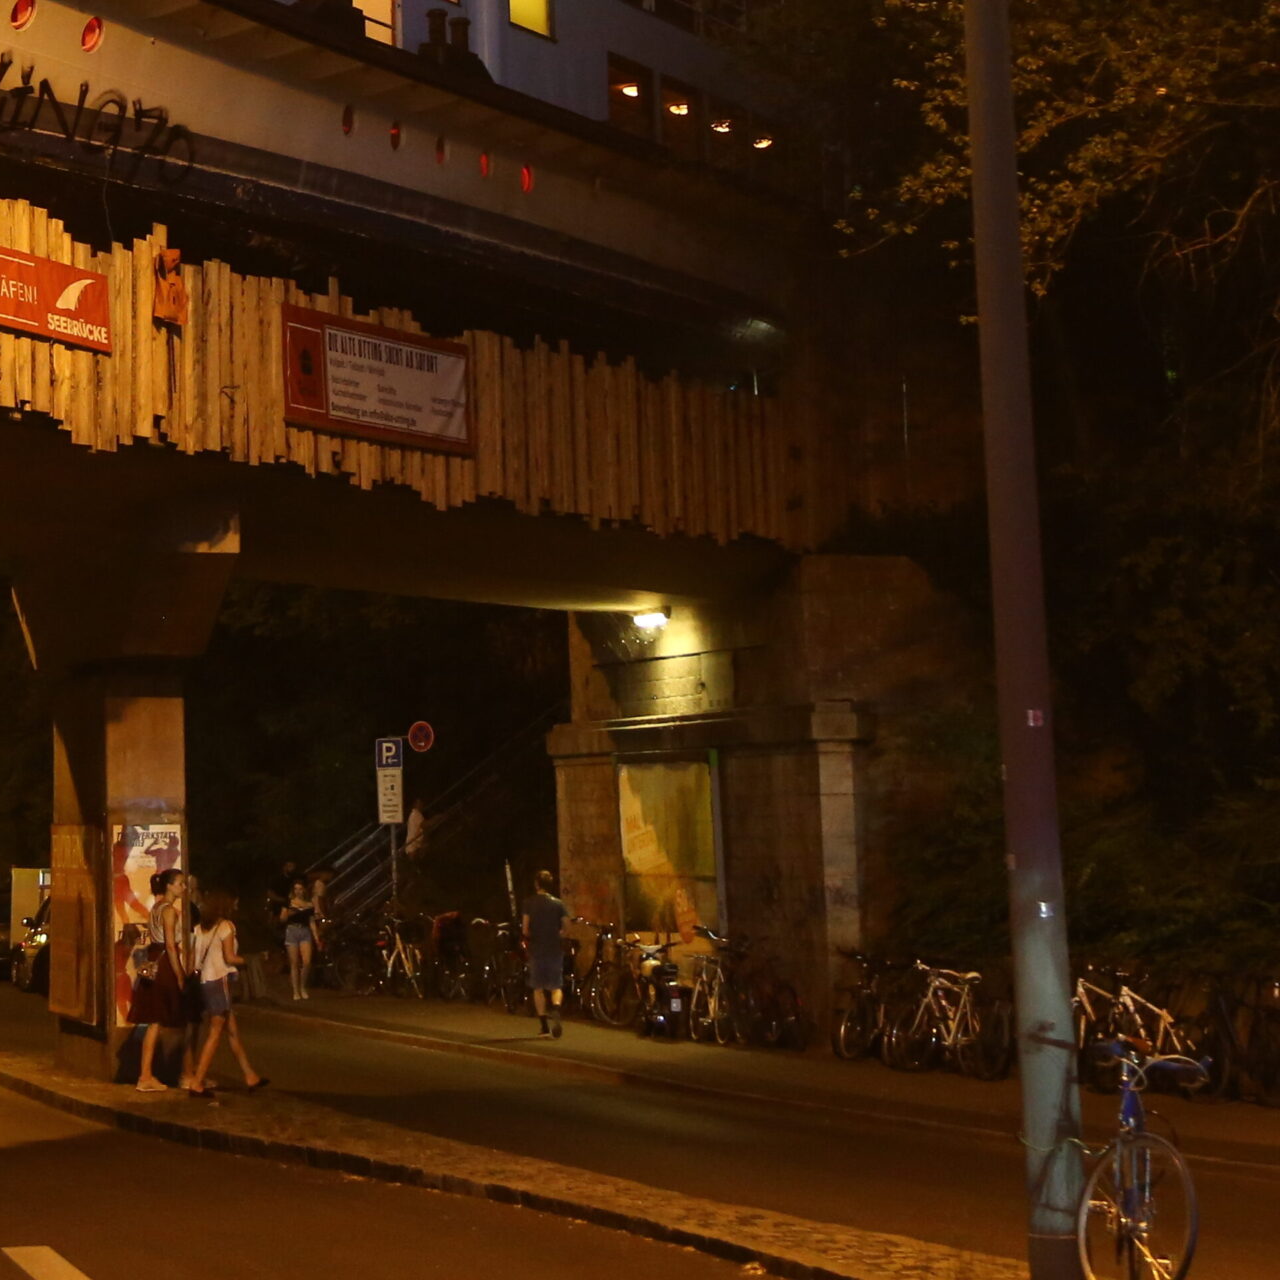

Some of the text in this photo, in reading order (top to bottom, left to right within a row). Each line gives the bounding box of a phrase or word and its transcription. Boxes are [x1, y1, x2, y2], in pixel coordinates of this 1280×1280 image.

[47, 312, 109, 344] SEEBRÜCKE
[328, 331, 339, 353] DIE
[340, 335, 357, 357] ALTE
[358, 338, 383, 362] UTTING
[382, 742, 396, 765] P
